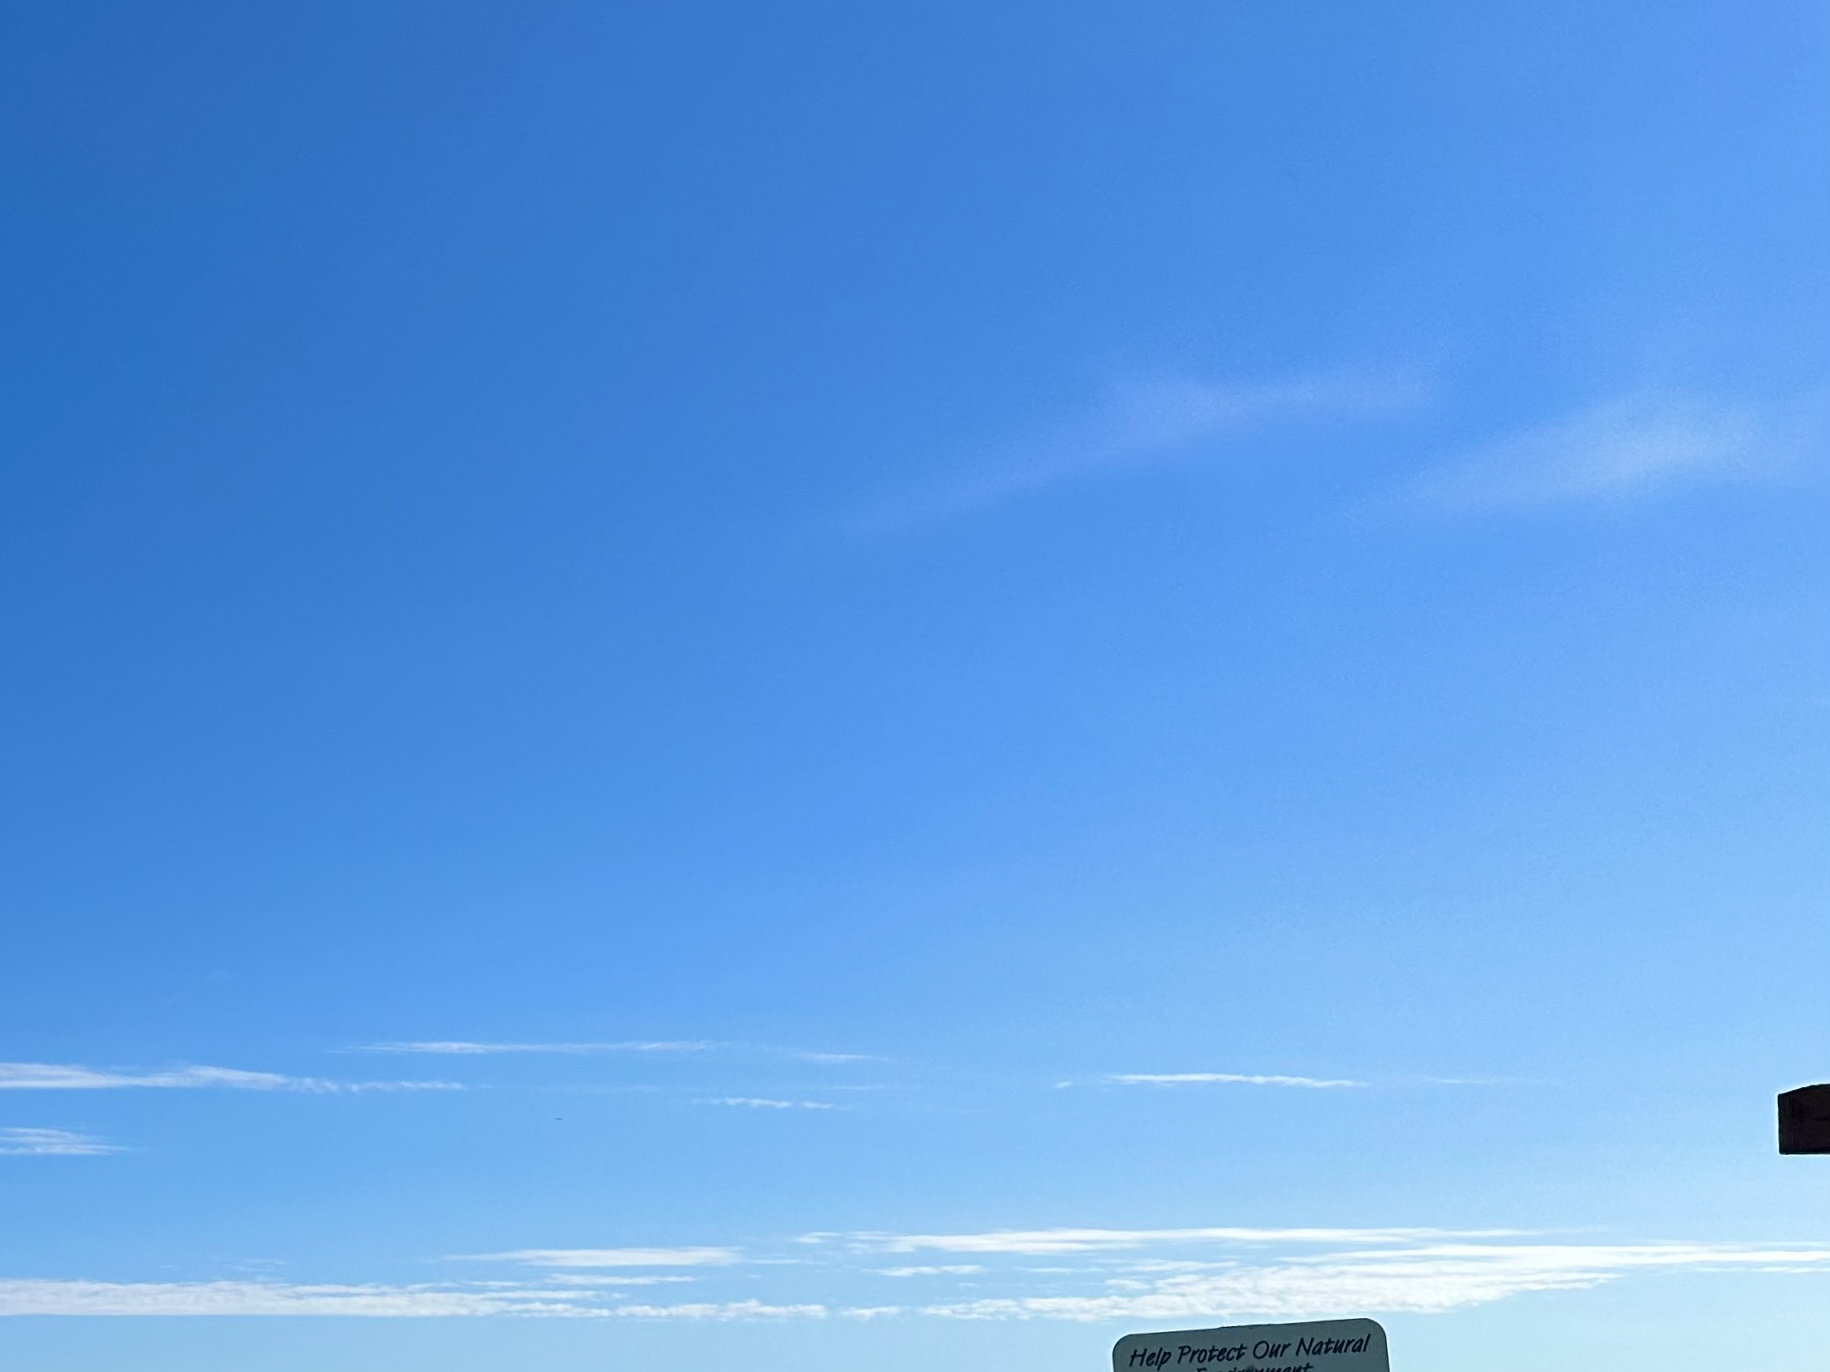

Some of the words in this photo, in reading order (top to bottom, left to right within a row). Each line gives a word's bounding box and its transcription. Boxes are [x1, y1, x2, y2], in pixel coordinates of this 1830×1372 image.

[1129, 1346, 1171, 1371] Help
[1177, 1343, 1247, 1364] Protect
[1252, 1340, 1293, 1360] Our
[1295, 1334, 1371, 1356] Natural
